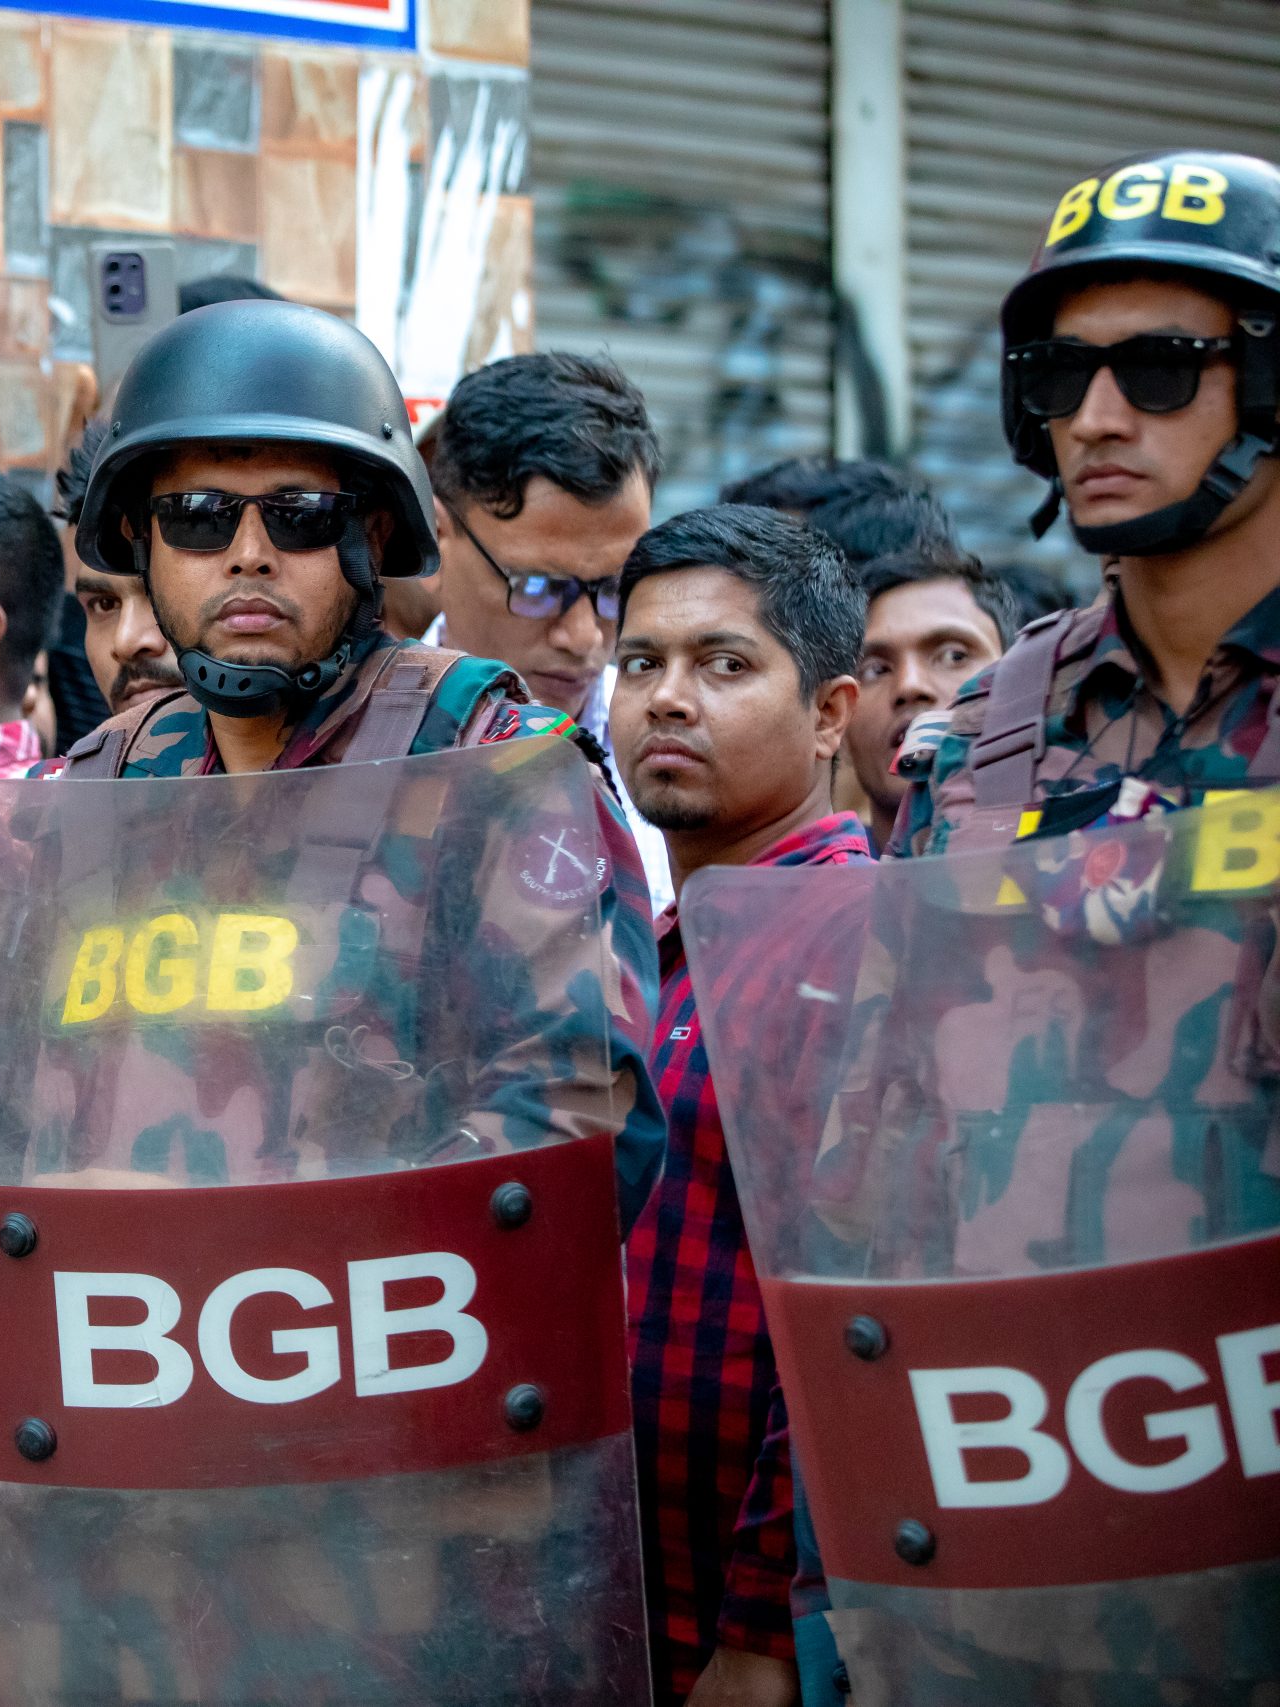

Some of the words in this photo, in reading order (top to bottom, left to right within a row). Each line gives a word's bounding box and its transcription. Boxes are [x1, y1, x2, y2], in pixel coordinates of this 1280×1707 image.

[1045, 163, 1228, 247] BGB
[61, 911, 299, 1025] BGB
[53, 1251, 489, 1409] BGB
